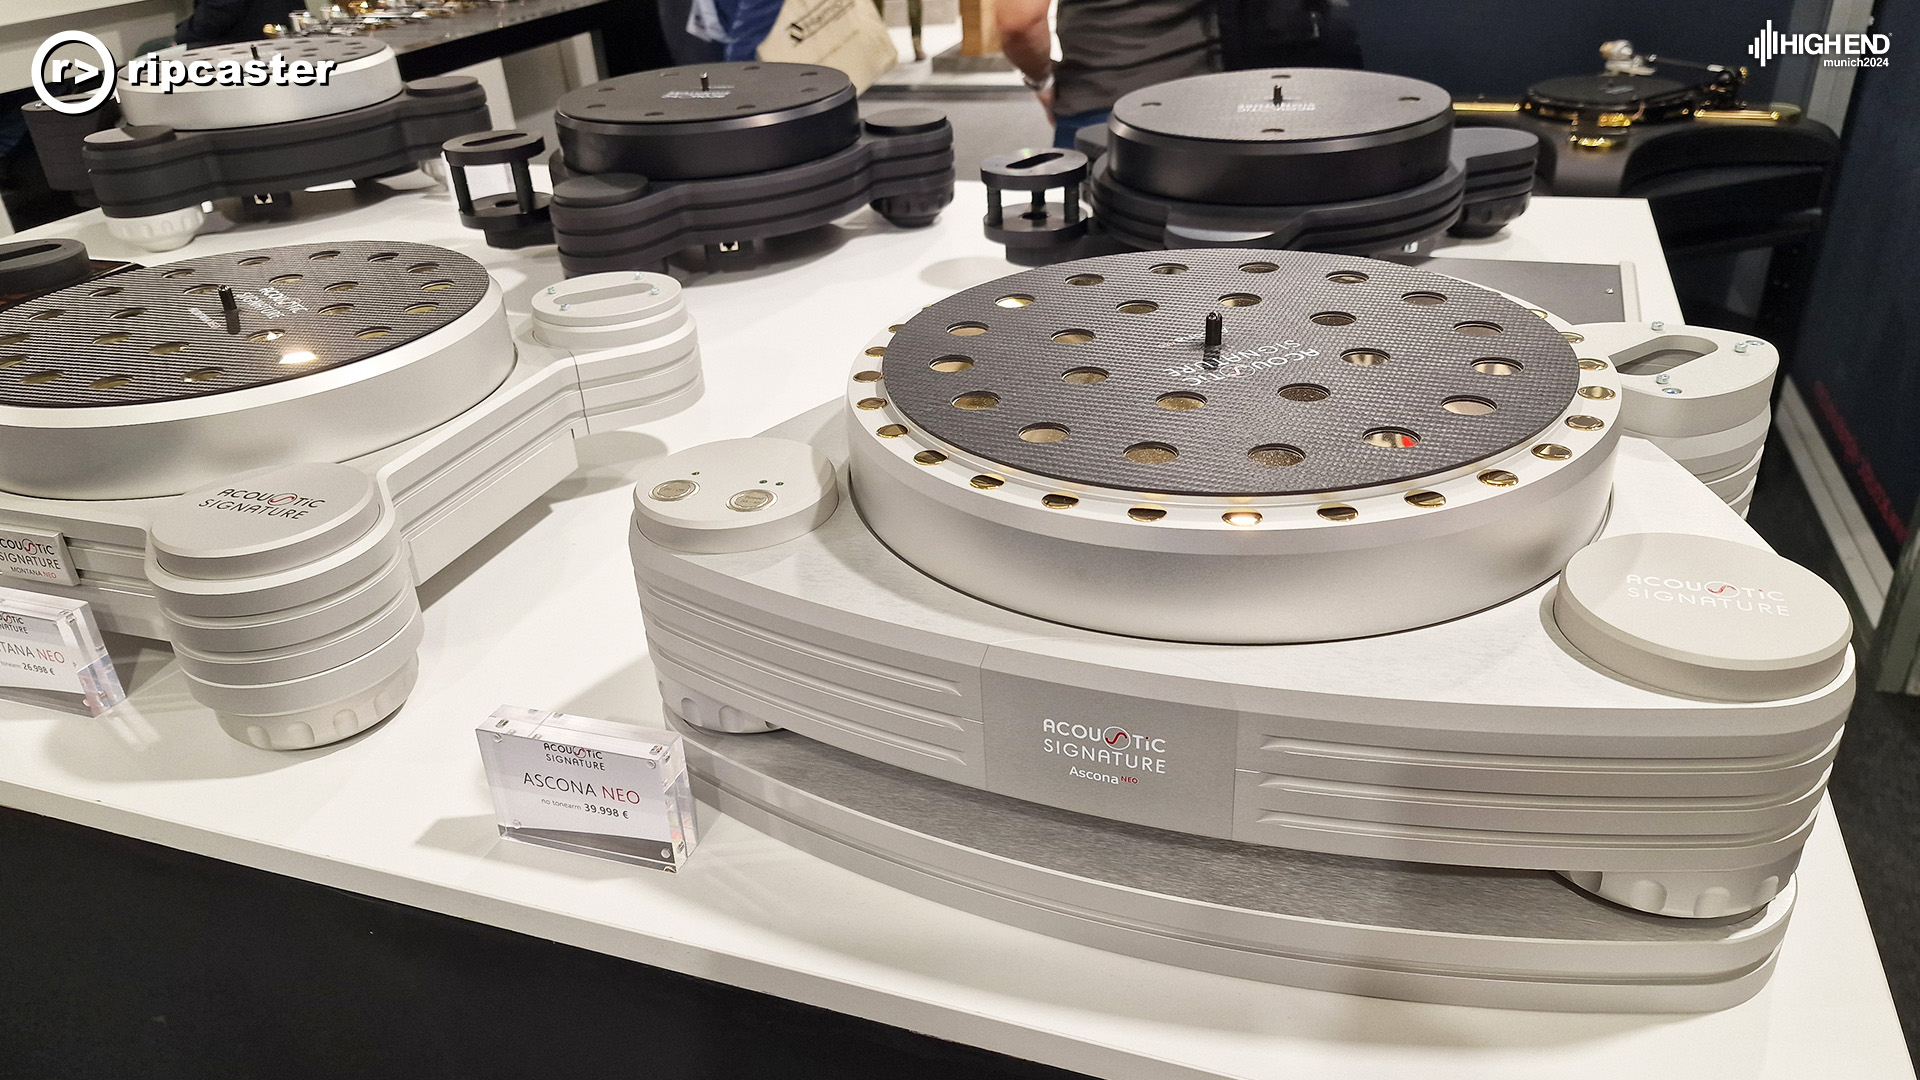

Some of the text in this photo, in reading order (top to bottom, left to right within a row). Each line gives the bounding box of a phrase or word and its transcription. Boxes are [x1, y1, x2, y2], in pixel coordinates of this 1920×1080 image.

[1163, 339, 1301, 377] SIGNATURE
[199, 498, 309, 520] SIGNATURE
[10, 566, 57, 579] MONTANA NEO
[1628, 587, 1790, 617] SIGNATURE
[0, 641, 65, 664] TANA NEO
[22, 662, 49, 674] 26.998
[49, 667, 56, 676] €
[545, 753, 606, 772] SIGNATURE
[1043, 738, 1166, 774] SIGNATURE
[1069, 766, 1138, 785] Ascona NEO
[523, 772, 641, 805] ASCONA NEO
[552, 798, 582, 810] tonearm
[584, 803, 620, 818] 39.998
[622, 810, 630, 819] €
